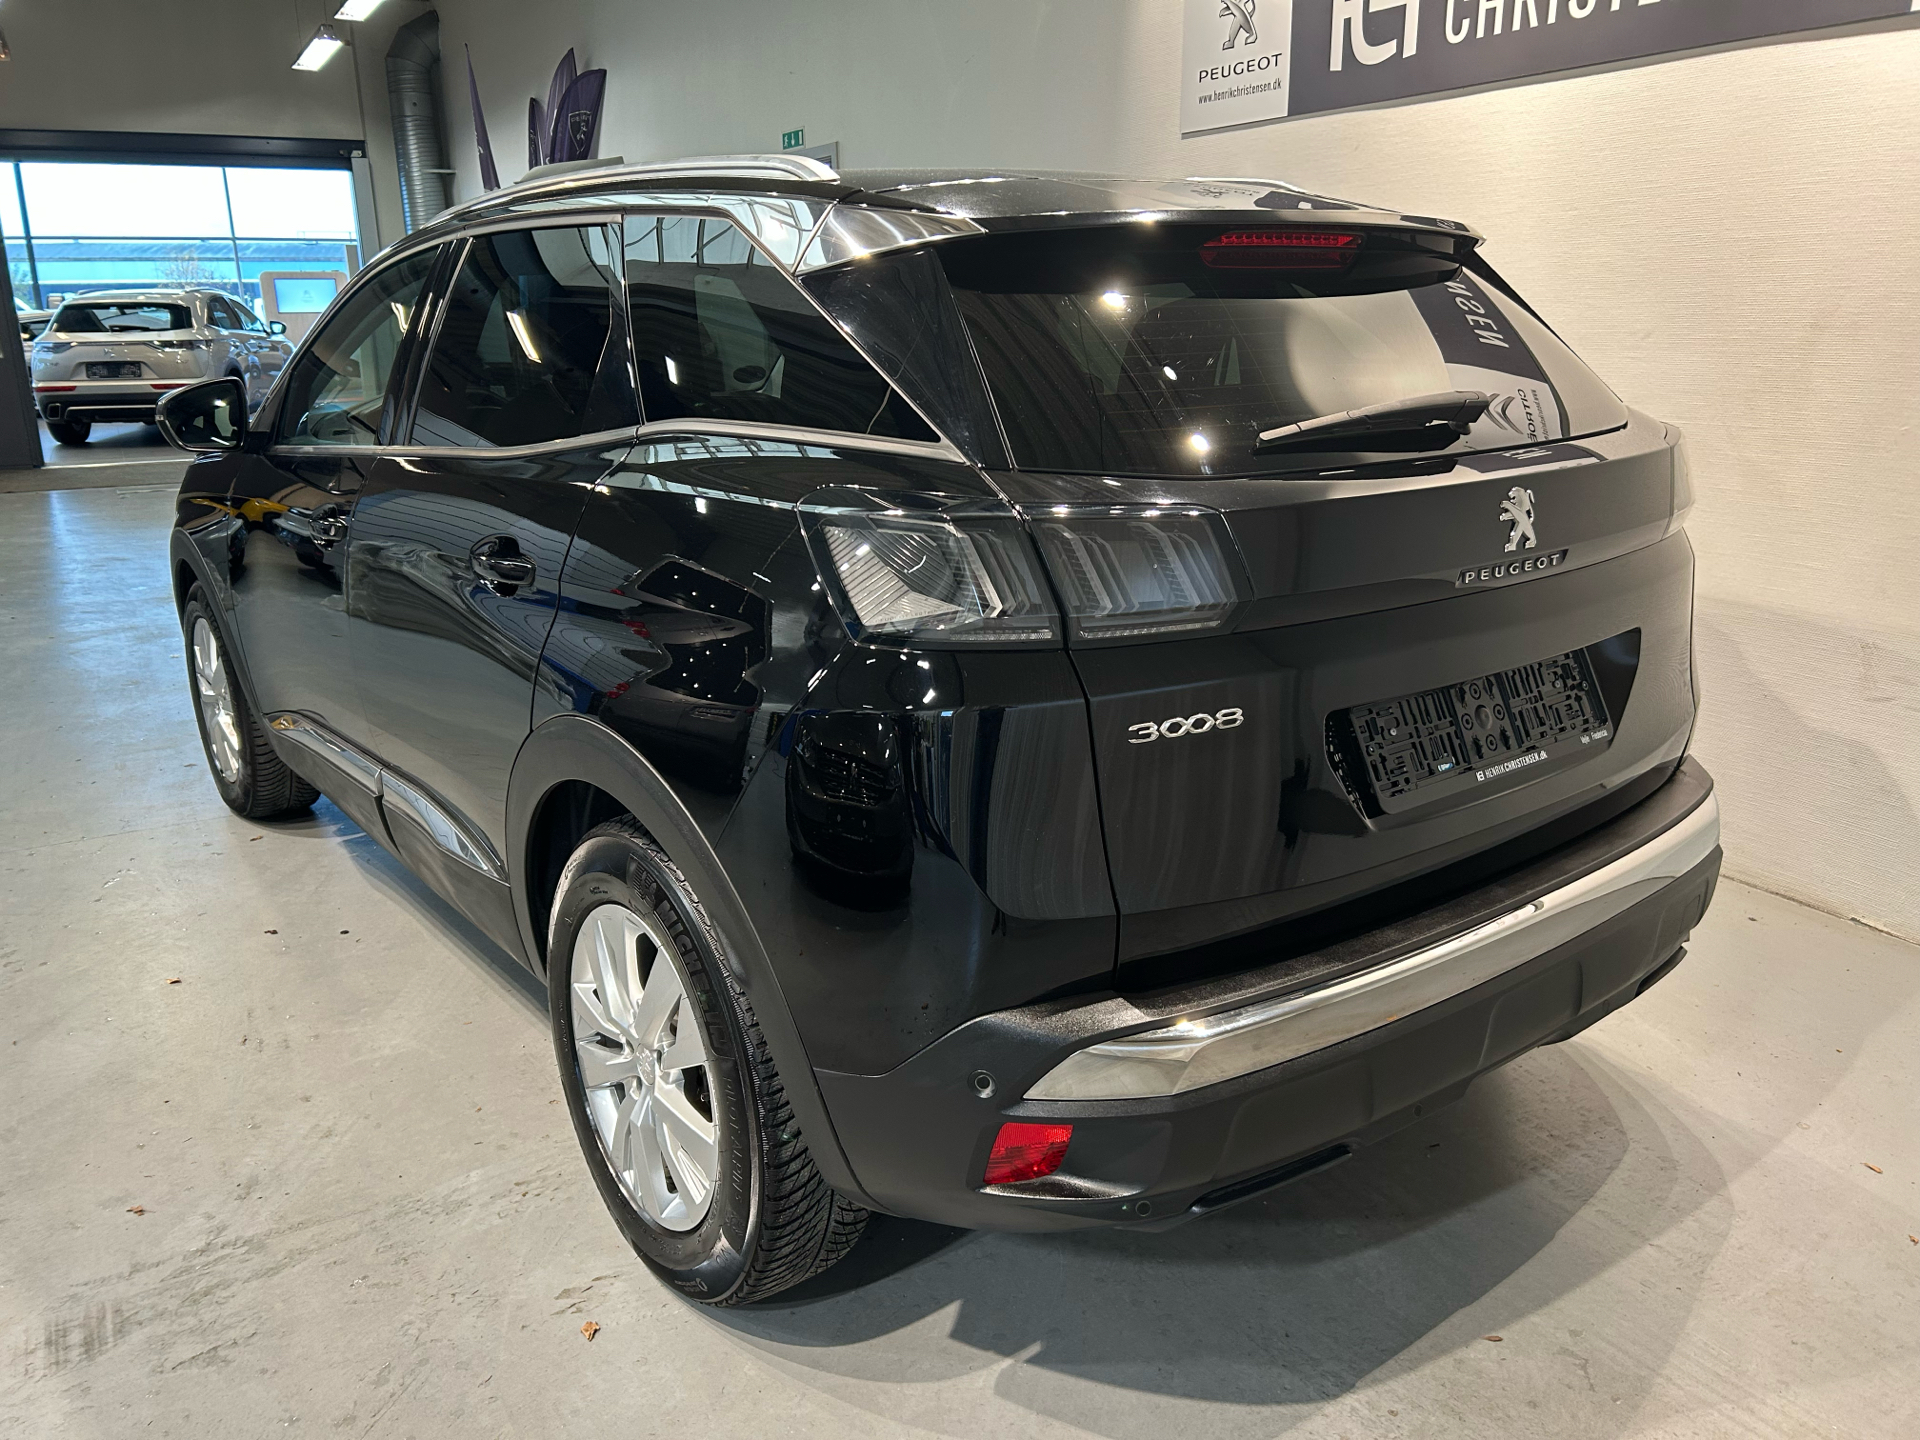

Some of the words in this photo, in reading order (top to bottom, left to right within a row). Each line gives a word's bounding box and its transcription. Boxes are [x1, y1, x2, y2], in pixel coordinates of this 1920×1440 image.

[1198, 52, 1282, 83] PEUGEOT
[1198, 77, 1282, 104] www.henrikchristensen.dk
[1465, 553, 1560, 584] PEUGEOT
[1127, 707, 1245, 744] 3008
